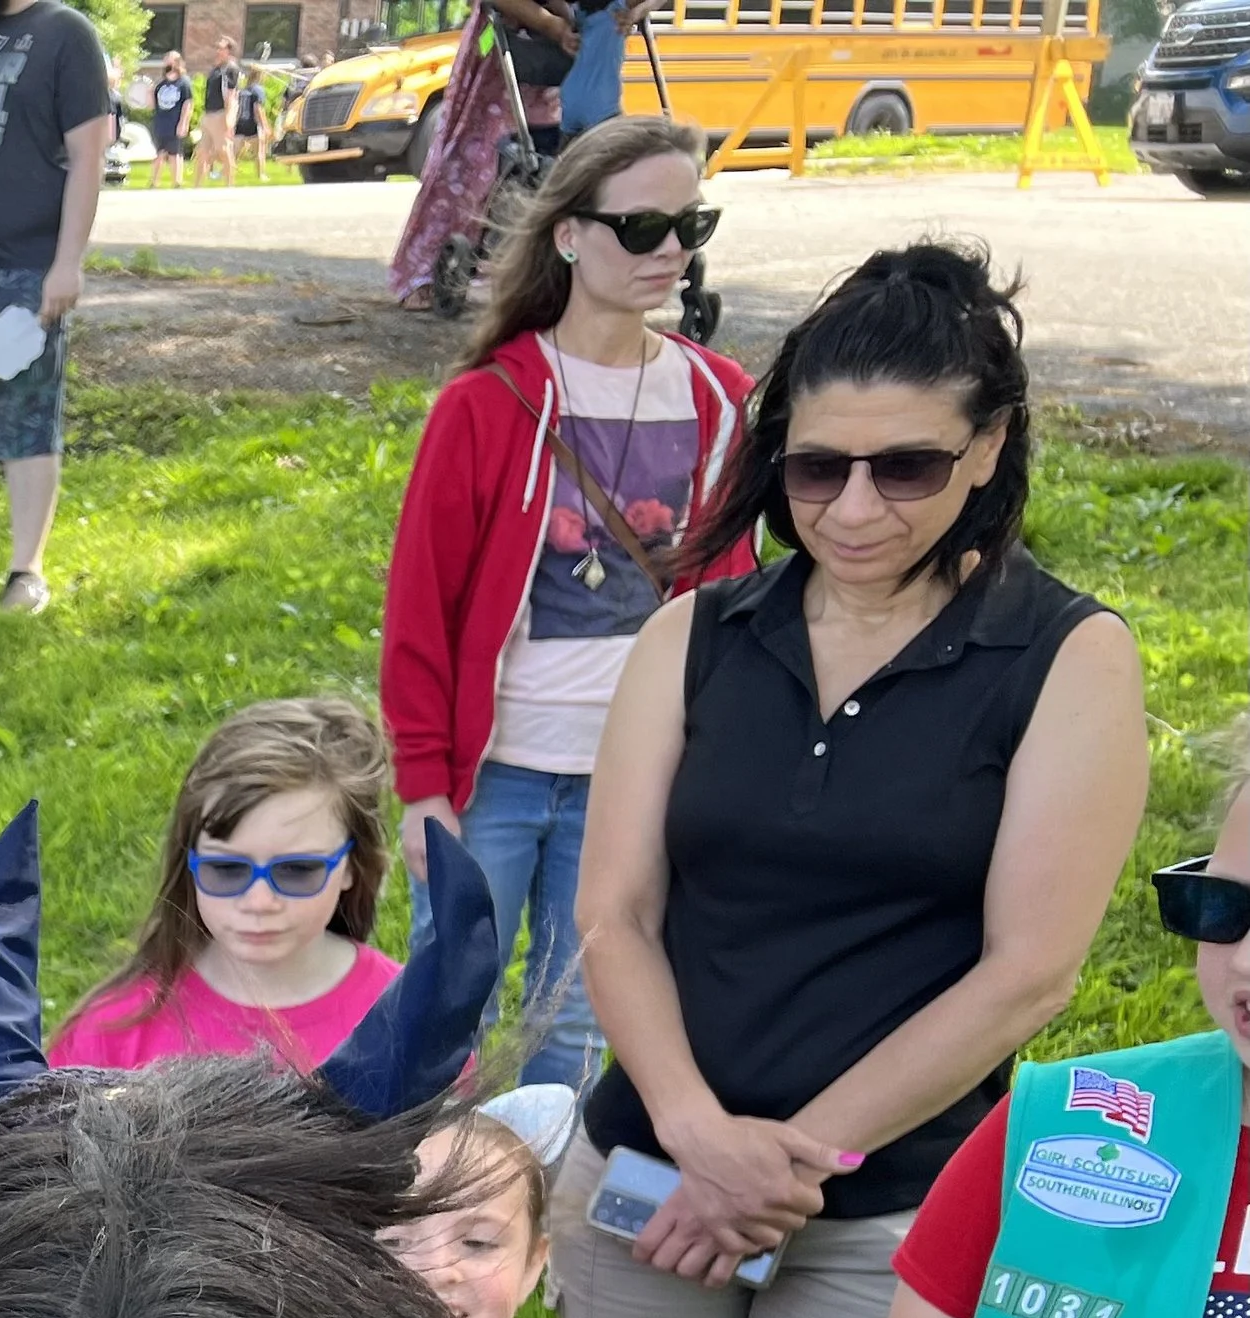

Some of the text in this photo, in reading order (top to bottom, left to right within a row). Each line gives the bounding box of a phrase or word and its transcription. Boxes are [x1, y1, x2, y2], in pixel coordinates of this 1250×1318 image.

[1035, 1149, 1170, 1188] GIRL SCOUTS USA
[1026, 1175, 1156, 1213] SOUTHERN ILLINOIS
